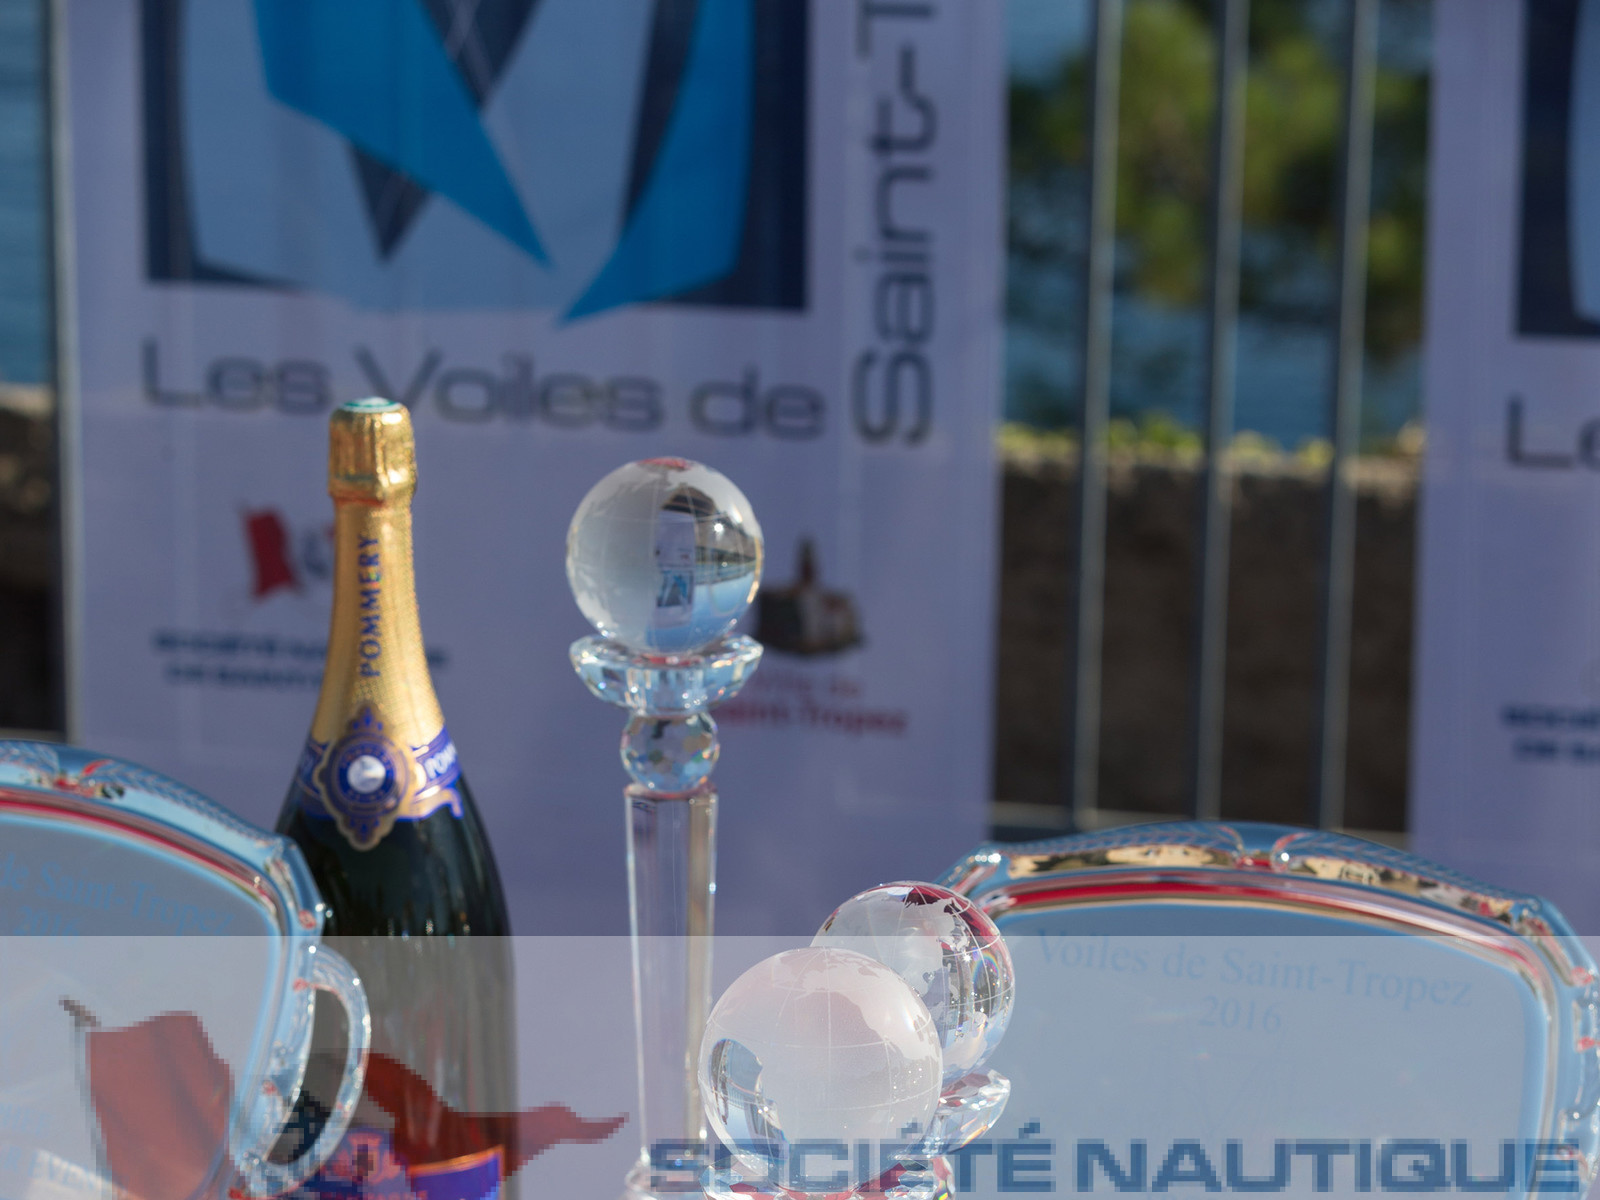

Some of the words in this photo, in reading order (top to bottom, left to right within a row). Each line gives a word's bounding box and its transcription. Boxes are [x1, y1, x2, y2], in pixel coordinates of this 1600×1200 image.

[142, 336, 332, 414] Les
[354, 346, 665, 434] Voiles
[688, 362, 827, 441] de
[357, 534, 382, 679] POMMERY
[36, 861, 235, 937] Saint-Tropez
[1037, 928, 1149, 974] Voiles
[1162, 942, 1207, 980] de
[1218, 947, 1474, 1012] Saint-Tropez
[1197, 994, 1283, 1034] 2016
